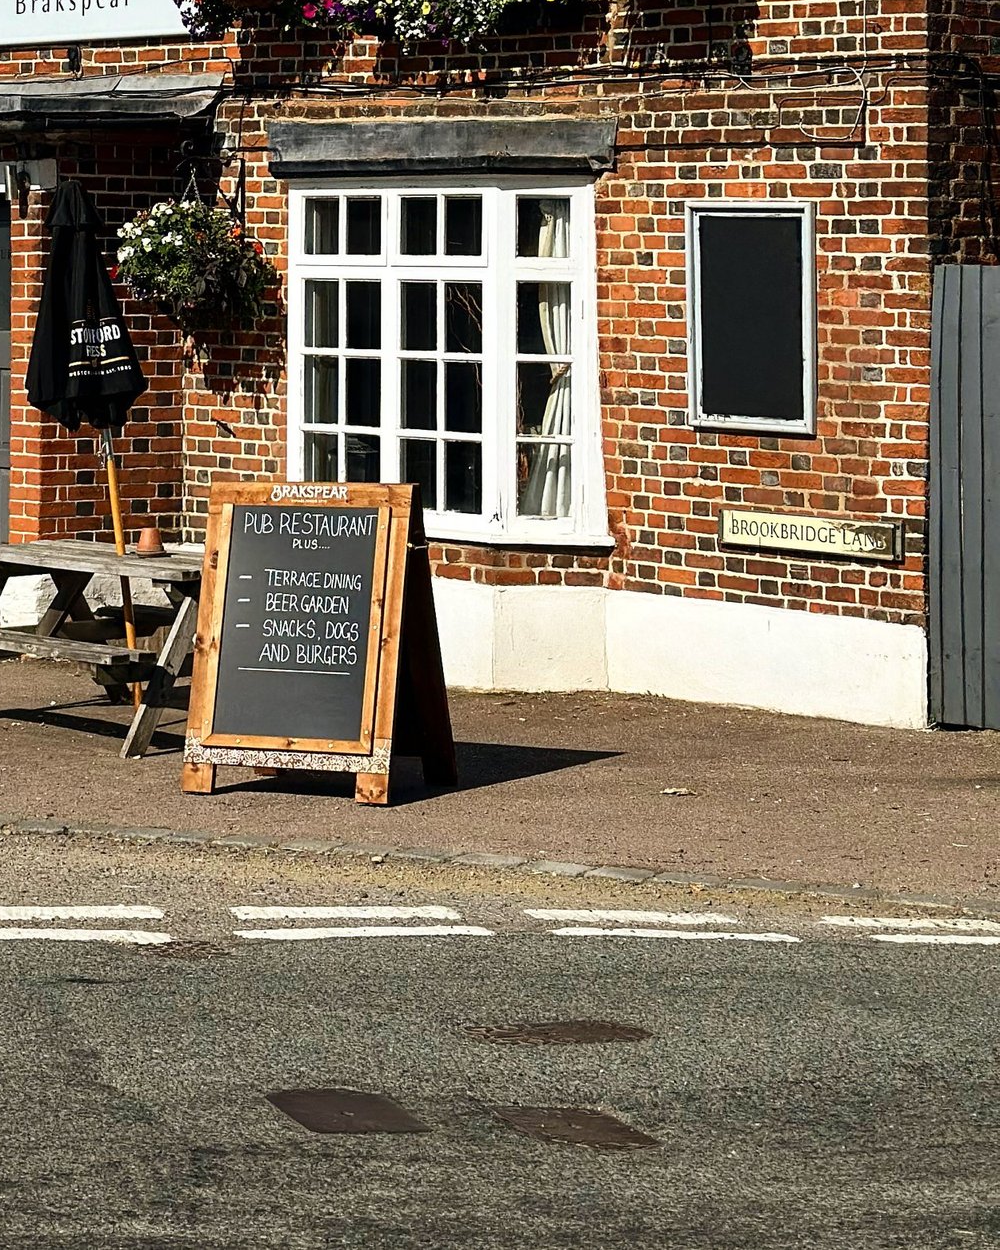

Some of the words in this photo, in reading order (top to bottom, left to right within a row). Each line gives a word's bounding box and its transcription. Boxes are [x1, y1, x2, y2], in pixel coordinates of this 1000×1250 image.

[271, 484, 347, 502] BRAKSPEAR
[244, 512, 274, 534] PUB
[279, 512, 378, 537] RESTAURANT
[731, 517, 836, 544] BROOKBRIDGE
[264, 568, 321, 588] TERRACE
[323, 572, 362, 591] DINING
[265, 593, 299, 612] BEER
[300, 595, 349, 614] GARDEN
[262, 619, 321, 641] SNACKS,
[325, 621, 359, 642] DOGS
[259, 643, 290, 662] AND
[296, 644, 357, 665] BURGERS
